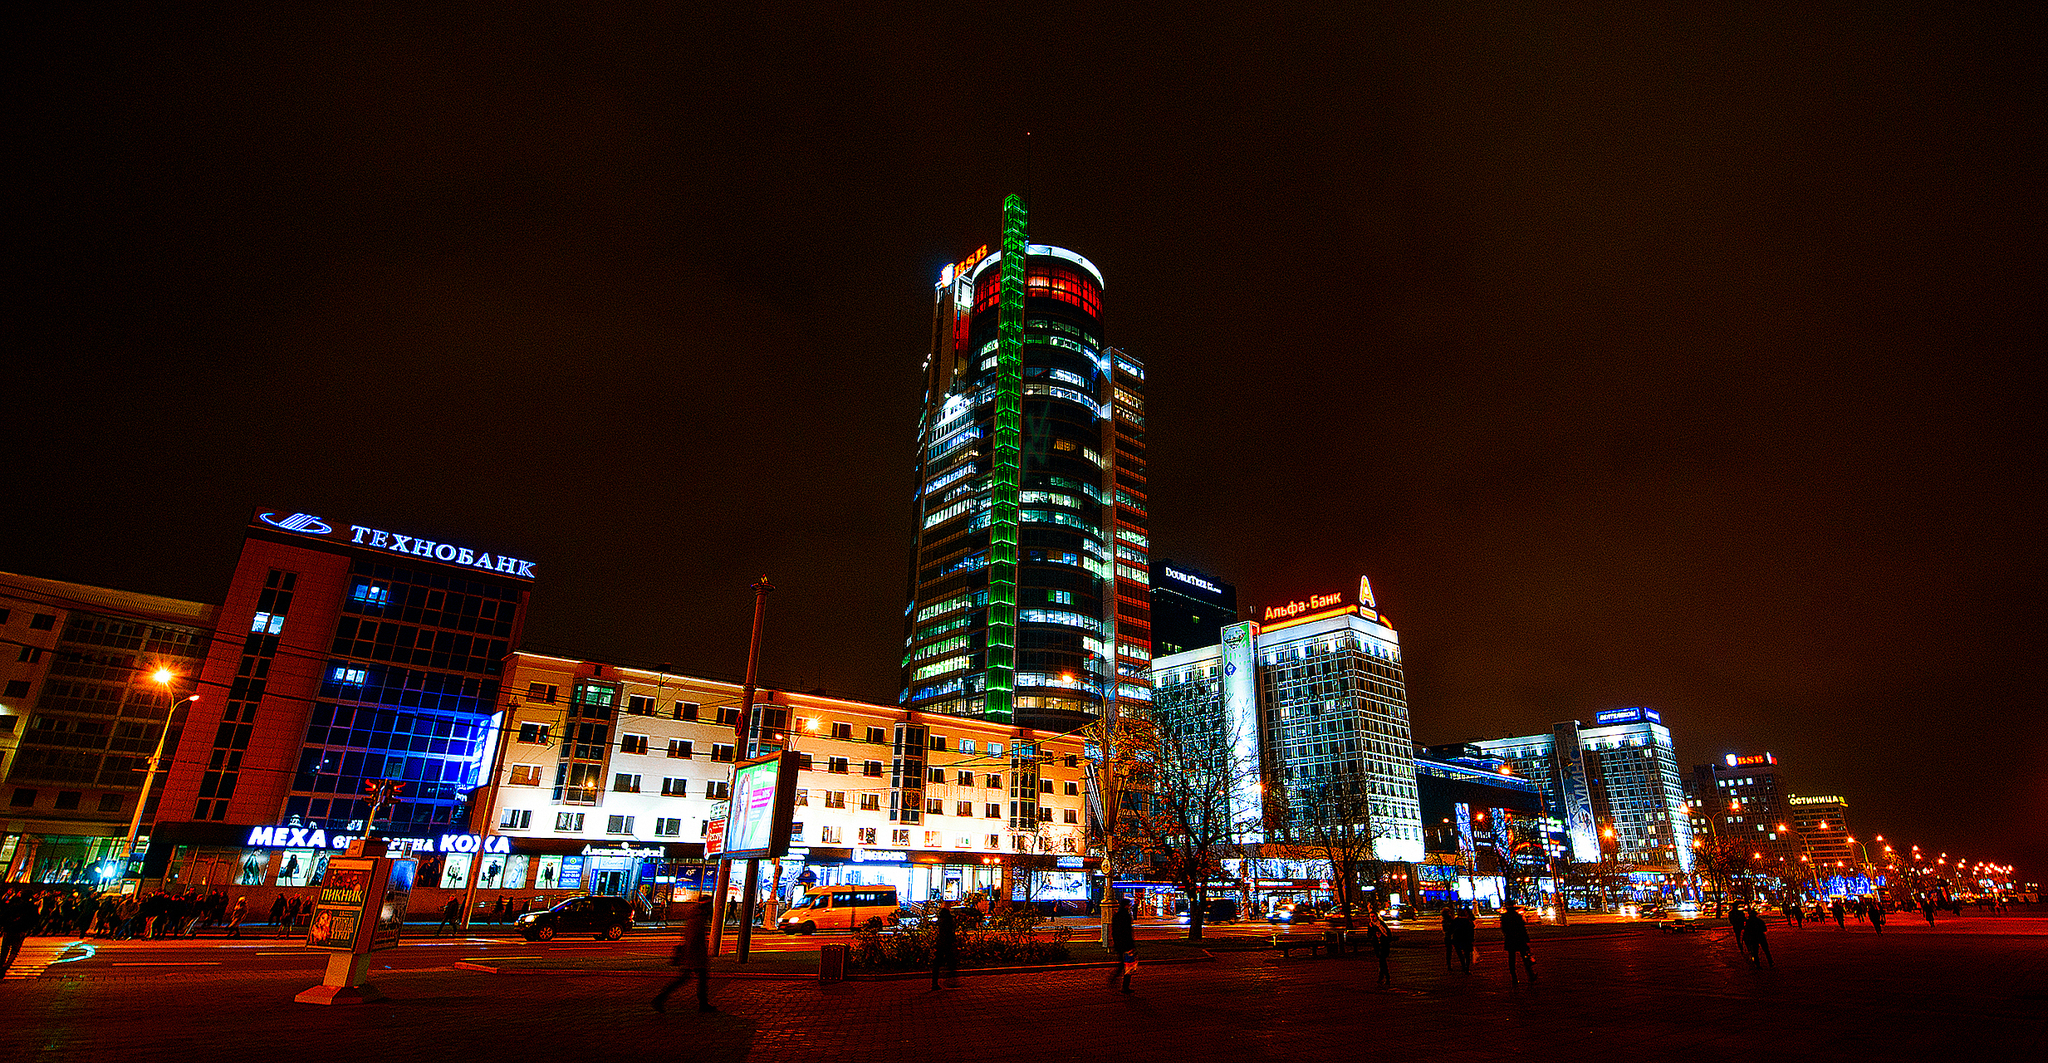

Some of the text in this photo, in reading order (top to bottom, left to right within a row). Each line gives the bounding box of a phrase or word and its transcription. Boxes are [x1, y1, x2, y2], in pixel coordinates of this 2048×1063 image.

[350, 524, 537, 579] ТЕХНОБАНК
[247, 826, 326, 848] МЕХА
[440, 834, 510, 853] КОЖА
[321, 888, 363, 902] ПИКНИК
